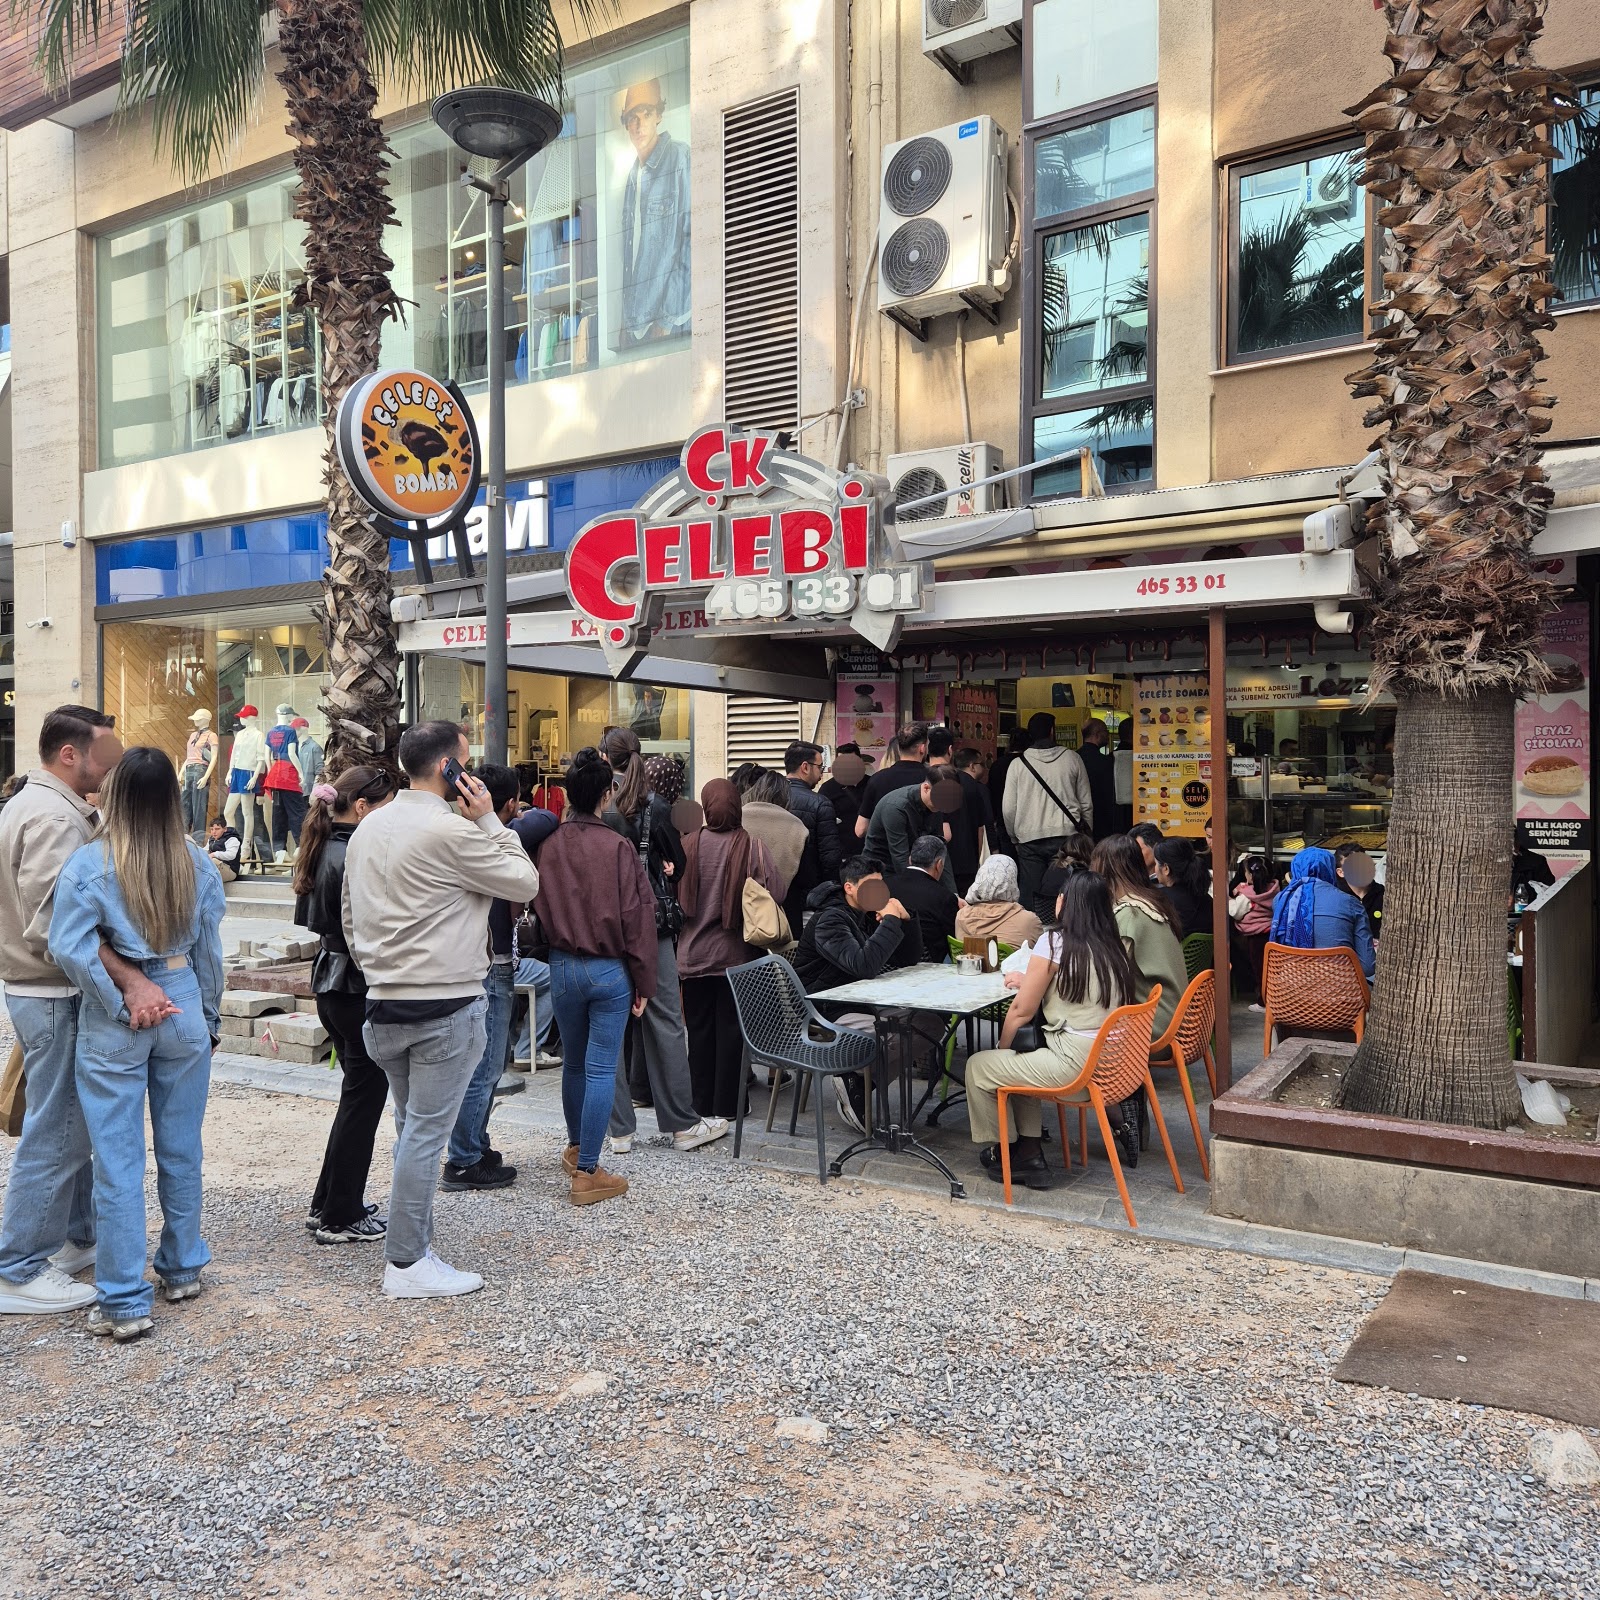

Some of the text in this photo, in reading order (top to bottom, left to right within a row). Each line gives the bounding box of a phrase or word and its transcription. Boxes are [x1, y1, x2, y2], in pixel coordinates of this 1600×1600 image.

[372, 381, 453, 429] ÇELEBİ
[393, 471, 459, 495] BOMBA
[567, 479, 871, 643] ÇELEBİ
[1136, 573, 1227, 596] 465 33 01
[709, 572, 913, 617] 465 33 01
[443, 617, 512, 645] ÇELEİ
[1268, 684, 1291, 692] ADRESİ
[1139, 688, 1210, 701] ÇELEBİ BOMBA
[1241, 692, 1270, 702] ŞUBEMİZ
[1534, 725, 1573, 736] BEYAZ
[1524, 737, 1583, 751] ÇİKOLATA
[1185, 786, 1206, 794] SELF
[1185, 795, 1206, 803] SERVİS
[1535, 820, 1548, 829] İLE
[1550, 822, 1582, 830] KARGO
[1528, 828, 1578, 838] SERVİSİMİZ
[1537, 838, 1570, 846] VARDIR
